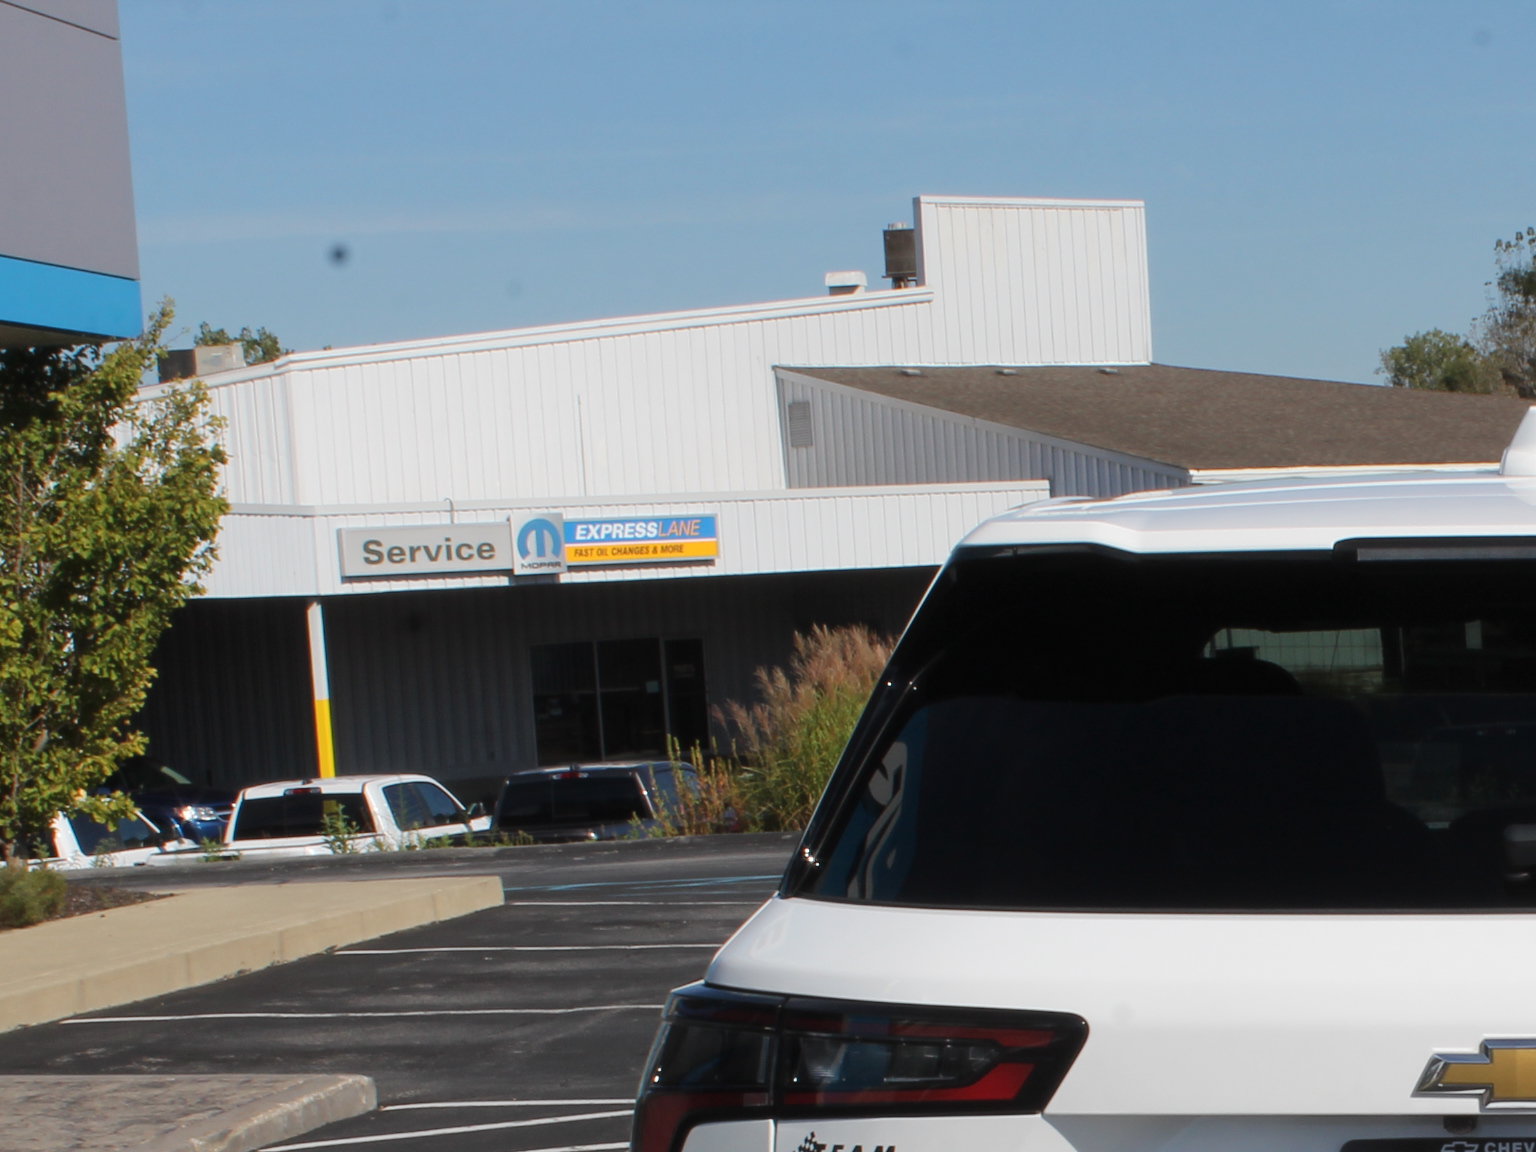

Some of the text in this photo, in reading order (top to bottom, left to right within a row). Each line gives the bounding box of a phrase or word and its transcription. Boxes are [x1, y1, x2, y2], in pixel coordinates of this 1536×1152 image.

[363, 537, 496, 566] Service
[574, 544, 684, 557] FAST OIL CHANGES & MORE
[521, 561, 562, 570] MOPAR
